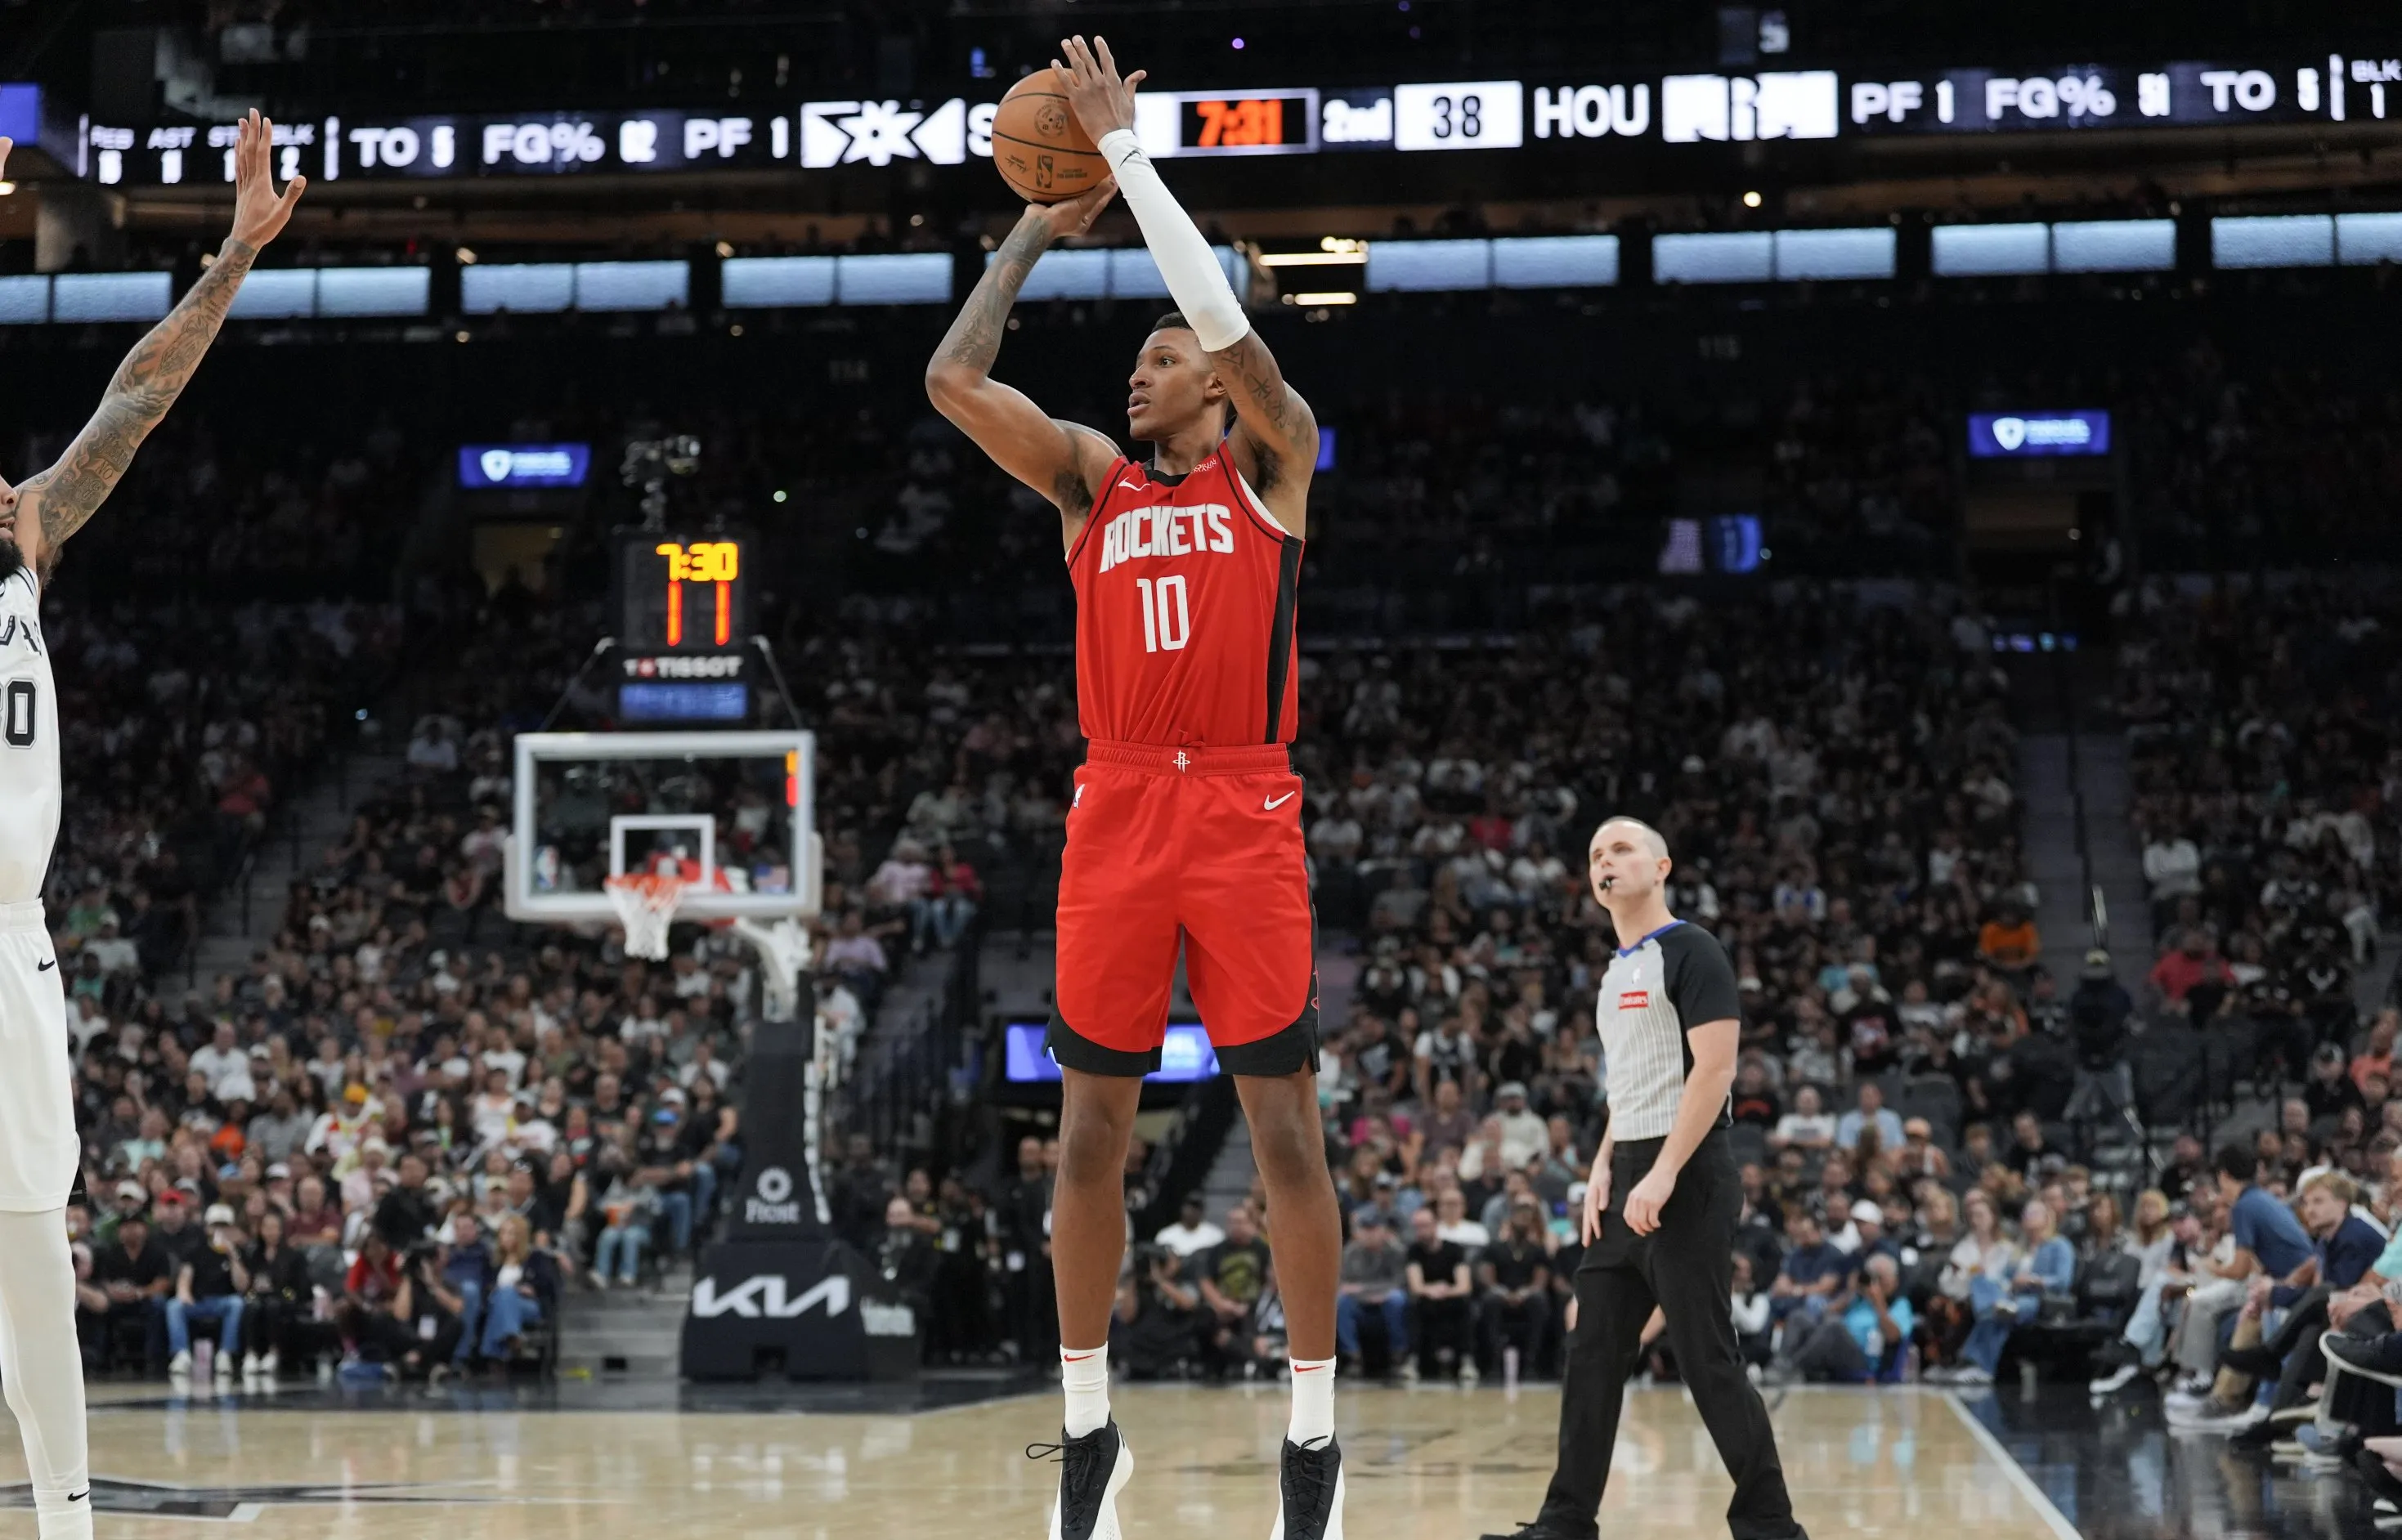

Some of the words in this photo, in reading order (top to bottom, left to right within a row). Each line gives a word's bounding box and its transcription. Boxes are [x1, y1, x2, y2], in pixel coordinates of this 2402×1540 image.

[1534, 83, 1650, 139] HOU
[1852, 82, 1923, 123] PF
[1936, 80, 1954, 123] 1
[1985, 76, 2116, 119] FG%
[2200, 70, 2276, 112] TO
[147, 127, 196, 149] AST
[684, 118, 752, 159] PF
[770, 117, 788, 159] 1
[1196, 98, 1284, 148] 7:31
[1323, 97, 1392, 143] 2nd
[1432, 95, 1481, 138] 38
[349, 127, 420, 168] TO
[483, 122, 605, 164] FG%
[1099, 503, 1235, 574] ROCKETS
[656, 542, 739, 582] 7:30
[666, 580, 730, 647] 11
[1136, 575, 1190, 653] 10
[656, 656, 742, 678] TISSOT
[0, 677, 38, 750] 0
